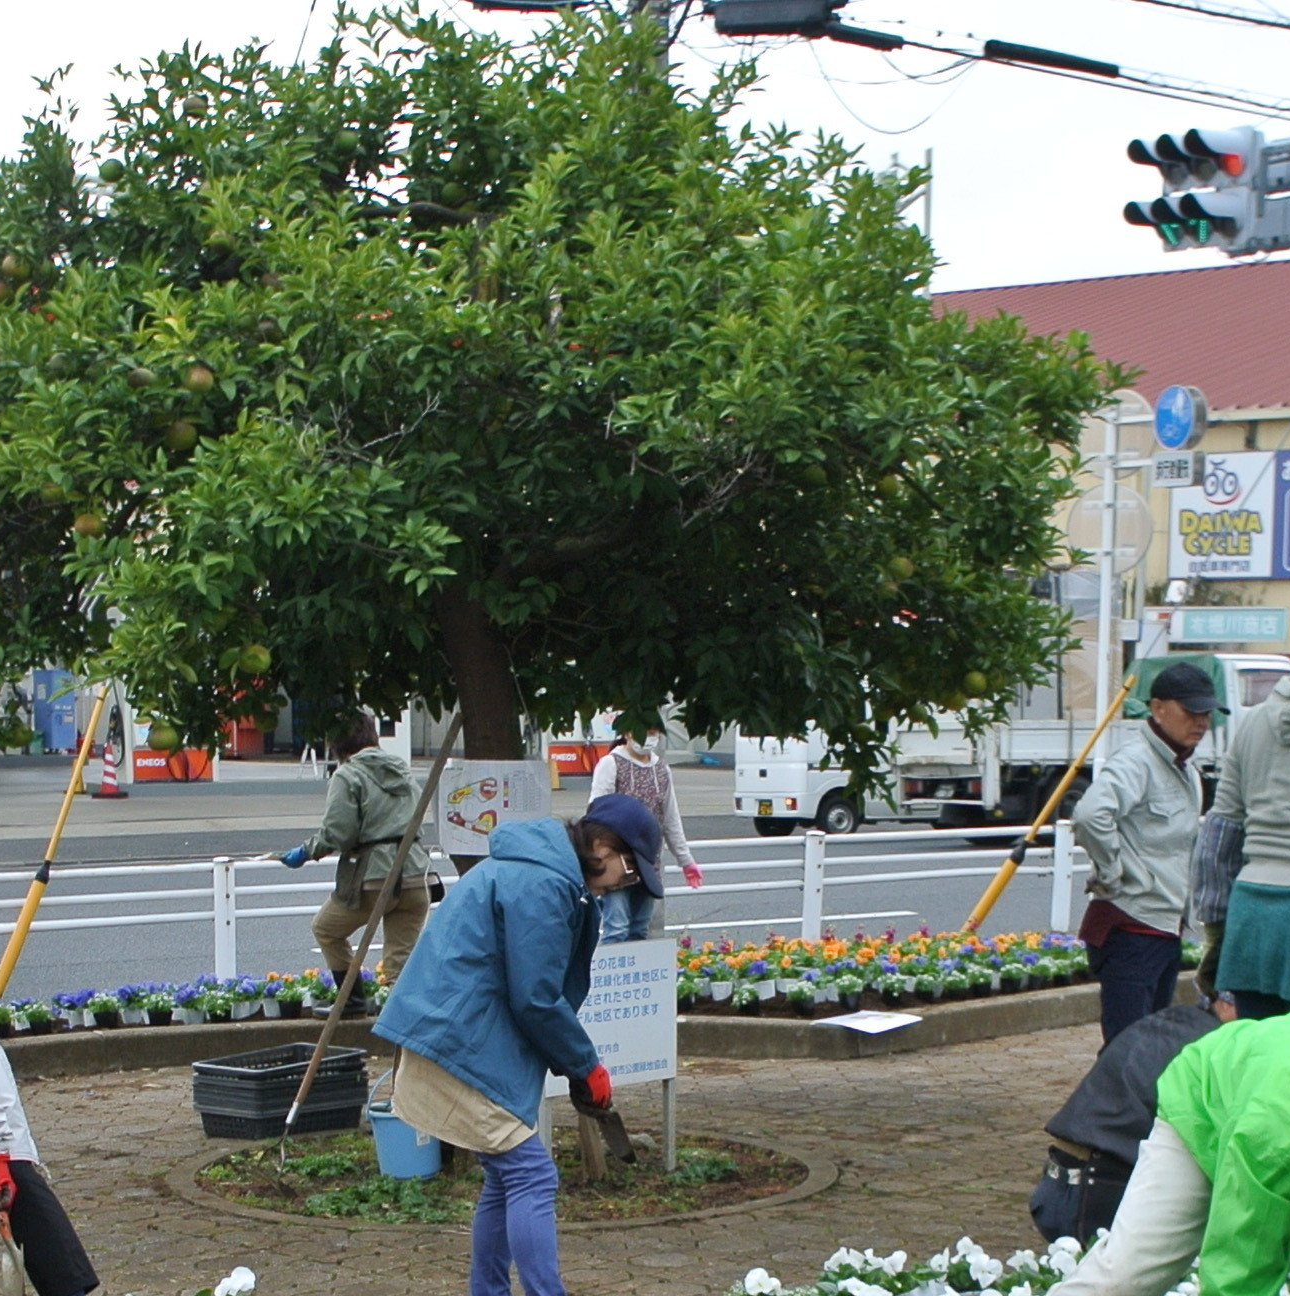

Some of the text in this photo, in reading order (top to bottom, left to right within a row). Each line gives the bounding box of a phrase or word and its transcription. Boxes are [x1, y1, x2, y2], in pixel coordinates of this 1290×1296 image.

[1178, 508, 1263, 536] DAIWA
[1182, 531, 1252, 557] CYCLE
[136, 757, 167, 768] ENEOS
[592, 968, 669, 989] 民緑化推進地区に
